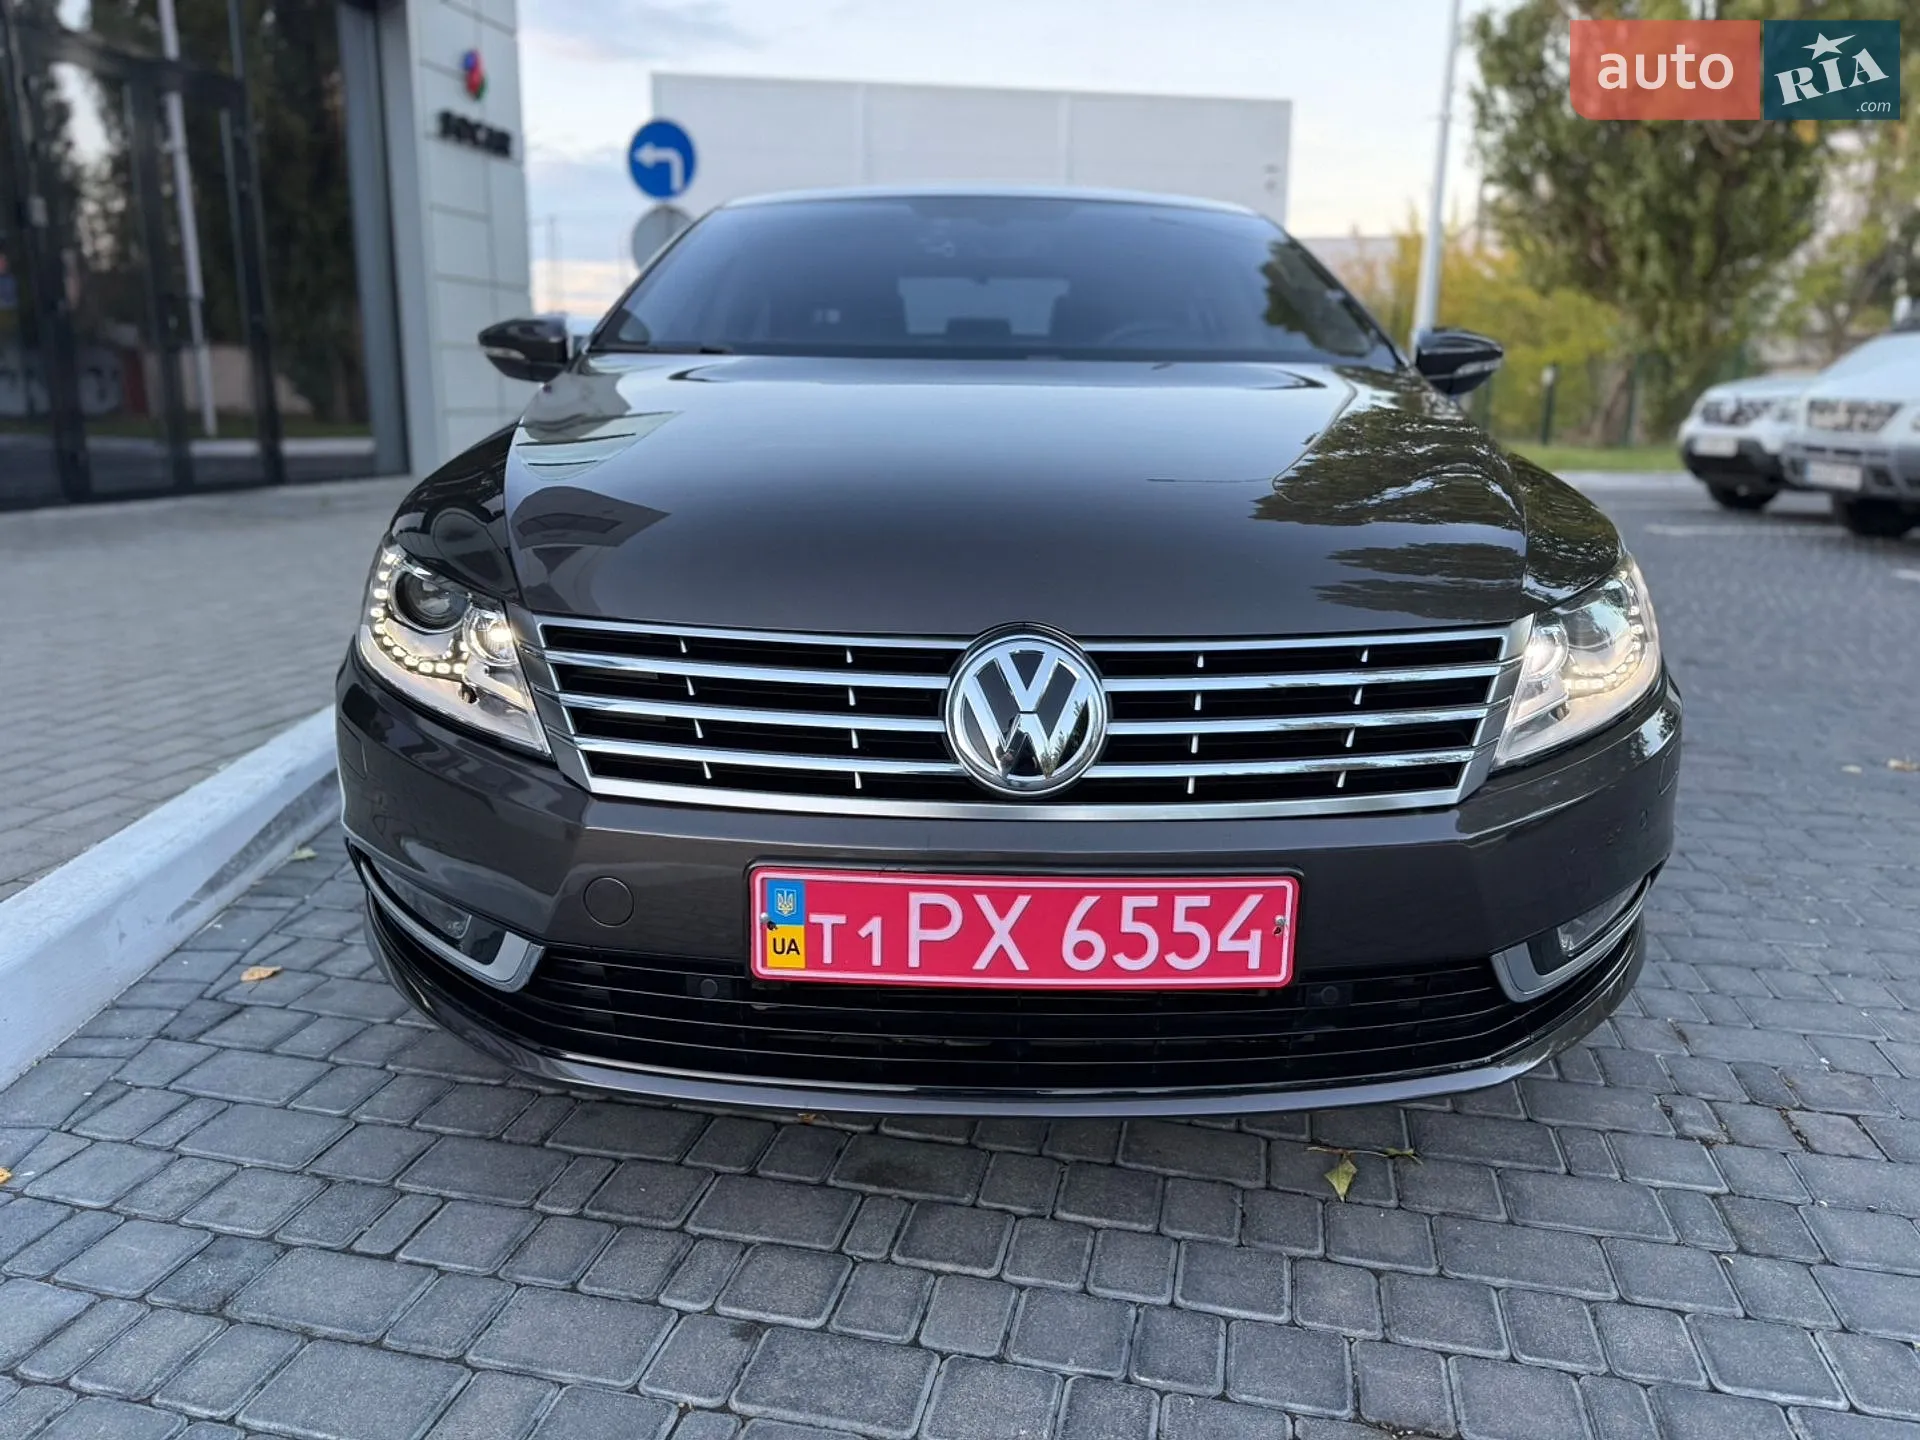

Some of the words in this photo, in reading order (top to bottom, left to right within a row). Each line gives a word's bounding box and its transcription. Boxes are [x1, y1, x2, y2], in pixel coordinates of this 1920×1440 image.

[772, 938, 800, 955] UA
[808, 913, 882, 967] T1
[908, 892, 1032, 971] PX
[1061, 894, 1264, 971] 6554
